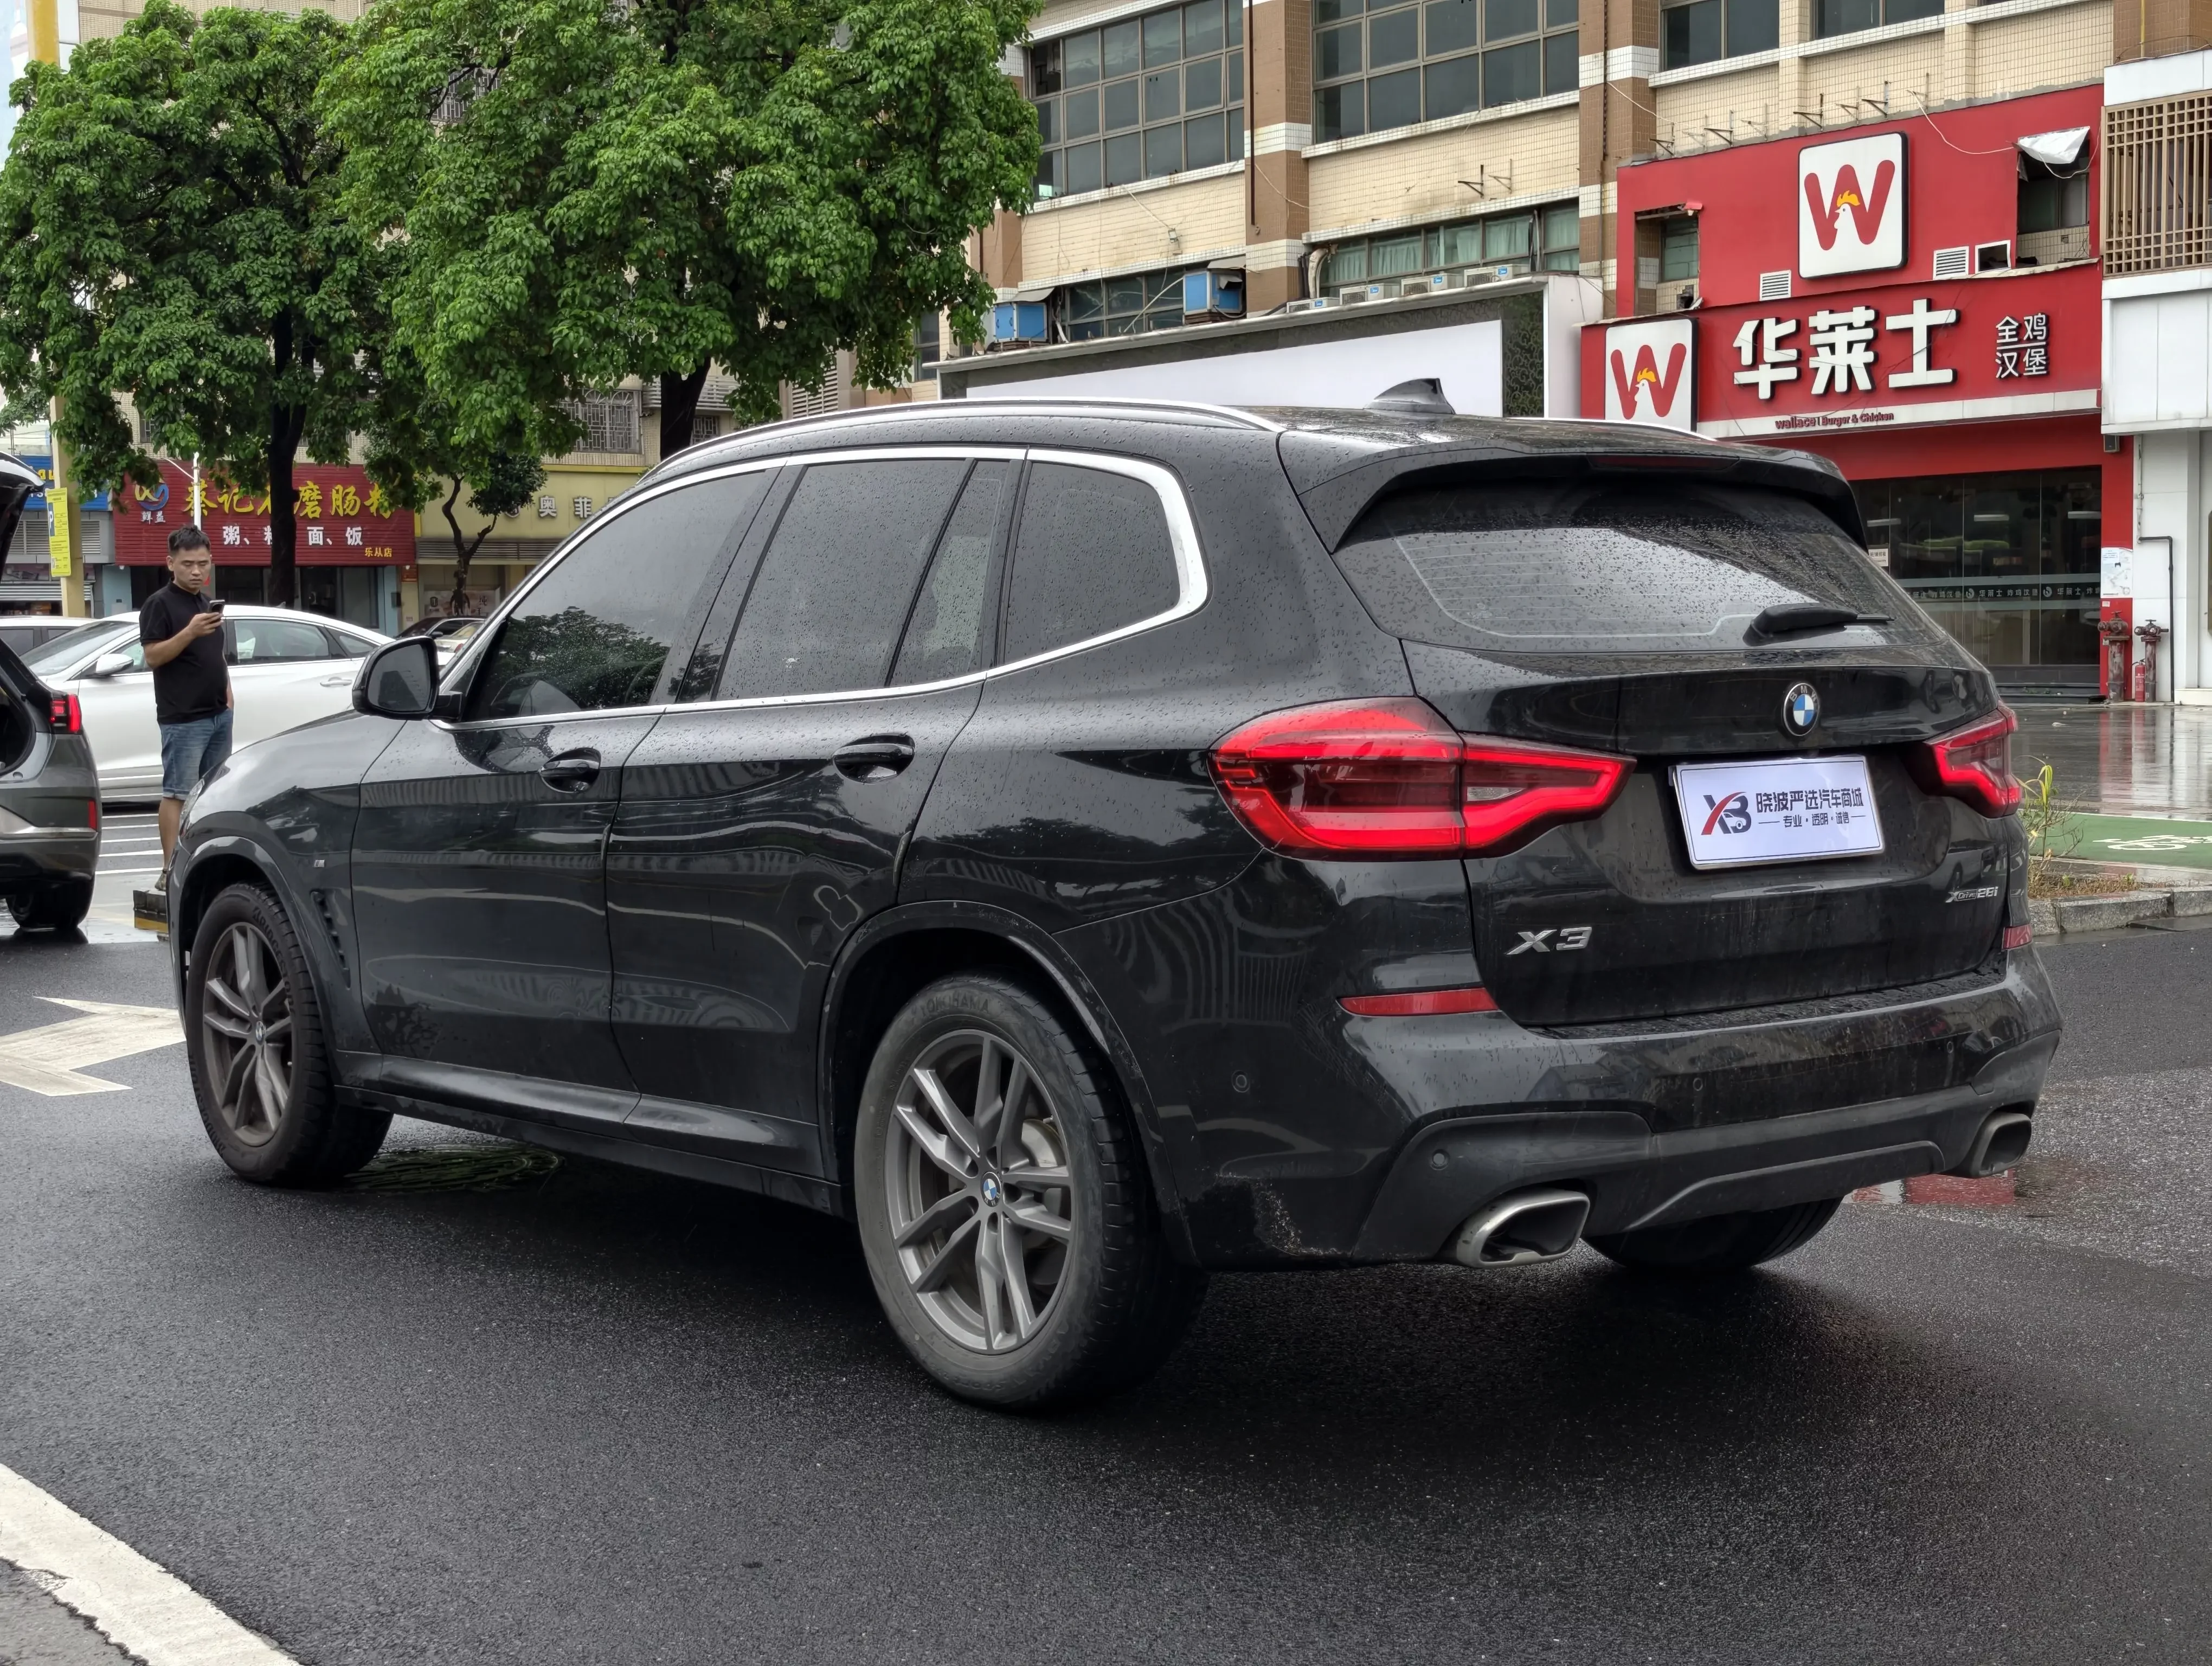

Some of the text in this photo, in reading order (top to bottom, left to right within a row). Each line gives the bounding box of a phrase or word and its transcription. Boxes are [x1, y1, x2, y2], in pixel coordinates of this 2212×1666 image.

[1996, 312, 2047, 344] 全鸡
[1733, 299, 1956, 399] 华莱士
[1995, 348, 2048, 379] 汉堡
[1822, 416, 1850, 427] Burger
[1851, 414, 1859, 423] &
[1860, 412, 1894, 422] Chicken
[538, 495, 616, 519] 奥菲
[223, 525, 363, 546] 粥、面、饭
[365, 547, 392, 558] 乐从店
[1789, 685, 1818, 702] BMW
[1756, 787, 1864, 813] 晓波严选汽车商城
[1505, 926, 1592, 955] X3
